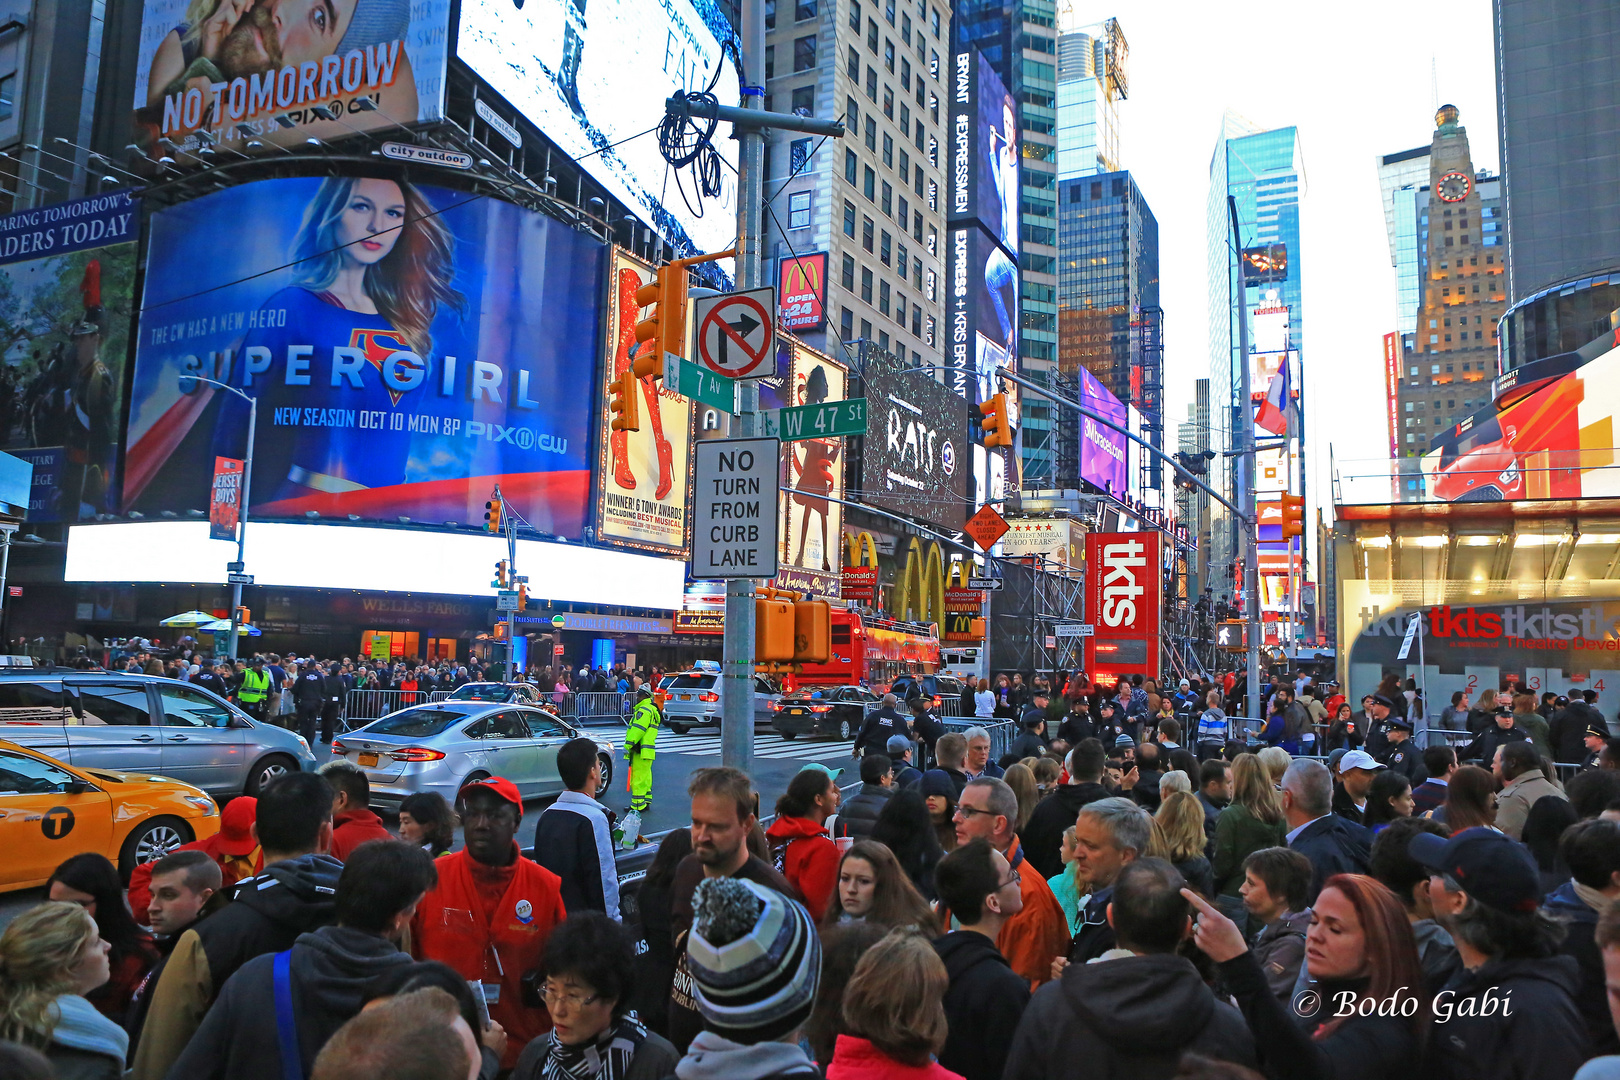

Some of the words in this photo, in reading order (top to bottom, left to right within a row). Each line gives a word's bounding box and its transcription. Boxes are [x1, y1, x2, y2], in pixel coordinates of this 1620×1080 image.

[162, 87, 203, 135] NO
[210, 39, 401, 124] TOMORROW
[956, 52, 969, 104] BRYANT
[390, 144, 415, 158] city
[418, 148, 466, 164] outdoor
[955, 113, 969, 213] #EXPRESSMEN
[43, 191, 133, 223] TOMORROW'S
[61, 213, 132, 246] TODAY
[954, 229, 968, 297] EXPRESS
[786, 293, 816, 304] OPEN
[789, 302, 813, 317] 24
[783, 315, 820, 327] HOURS
[1254, 307, 1288, 315] TOSHIBA
[151, 325, 168, 346] THE
[170, 323, 185, 342] CW
[187, 318, 208, 339] HAS
[209, 316, 217, 334] A
[220, 311, 245, 332] NEW
[249, 308, 287, 329] HERO
[954, 311, 968, 342] KRIS
[178, 344, 540, 410] SUPERGIRL
[953, 344, 968, 399] BRYANT
[696, 370, 704, 397] 7
[709, 376, 721, 395] AV
[273, 407, 301, 426] NEW
[303, 407, 355, 428] SEASON
[359, 410, 387, 430] OCT
[389, 412, 404, 431] 10
[408, 413, 439, 435] MON
[442, 417, 461, 436] 8P
[703, 409, 718, 430] A
[785, 410, 804, 437] W
[814, 407, 839, 433] 47
[848, 404, 863, 421] St
[718, 450, 755, 473] NO
[212, 473, 242, 488] JERSEY
[712, 477, 760, 496] TURN
[215, 488, 236, 503] BOYS
[606, 492, 635, 510] WINNER!
[635, 498, 641, 512] 6
[641, 500, 658, 515] TONY
[658, 503, 683, 520] AWARDS
[606, 507, 637, 520] INCLUDING
[637, 512, 655, 523] BEST
[655, 516, 682, 528] MUSICAL
[711, 501, 760, 520] FROM
[710, 525, 759, 543] CURB
[709, 548, 758, 567] LANE
[1102, 539, 1147, 628] tkts
[362, 598, 424, 613] WELLS
[426, 601, 472, 615] FARGO
[1358, 605, 1429, 637] tkts
[1428, 605, 1503, 639] tkts
[1501, 605, 1580, 640] tkts
[1504, 636, 1568, 650] Theatre
[1467, 674, 1478, 688] 2
[1529, 676, 1541, 690] 3
[1594, 678, 1605, 692] 4
[24, 815, 42, 823] NYC
[49, 812, 68, 836] T
